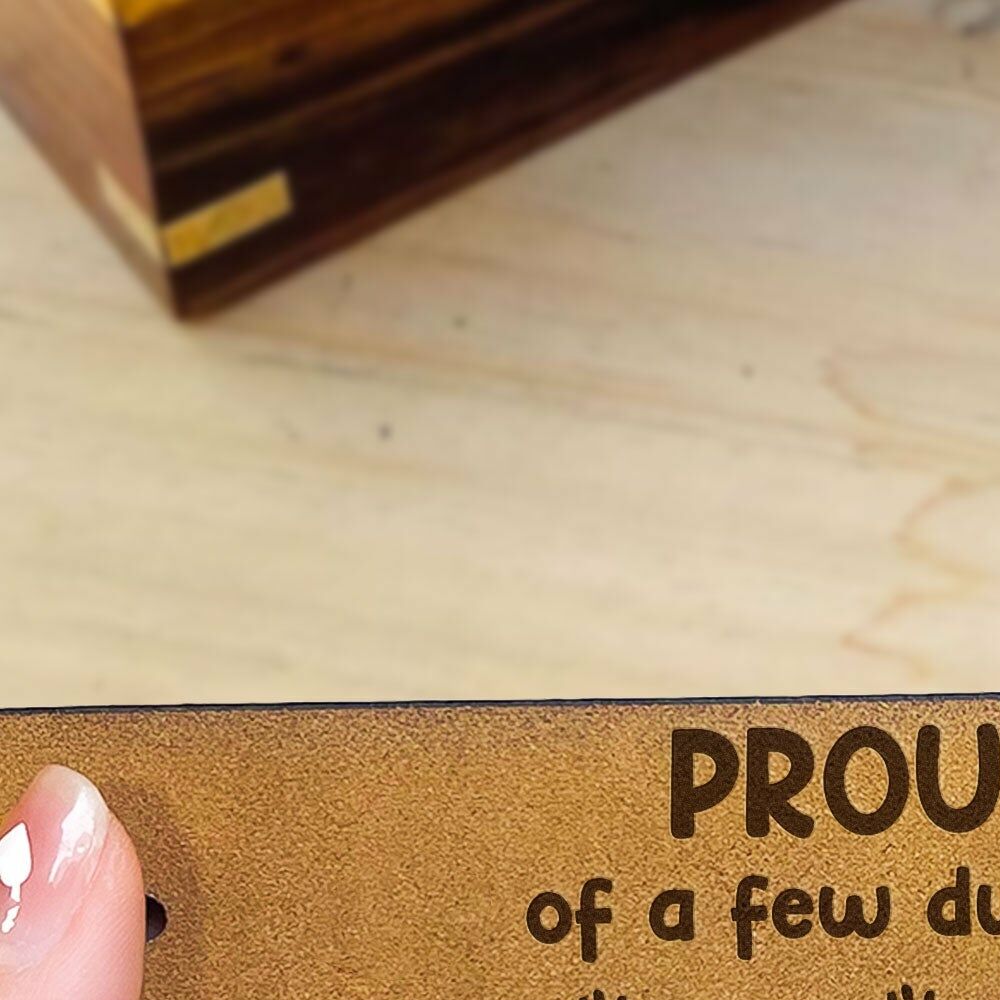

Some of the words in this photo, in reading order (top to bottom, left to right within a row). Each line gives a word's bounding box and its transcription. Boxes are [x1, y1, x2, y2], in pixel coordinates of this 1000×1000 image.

[526, 877, 613, 963] of
[649, 888, 695, 942] a
[730, 874, 891, 961] few
